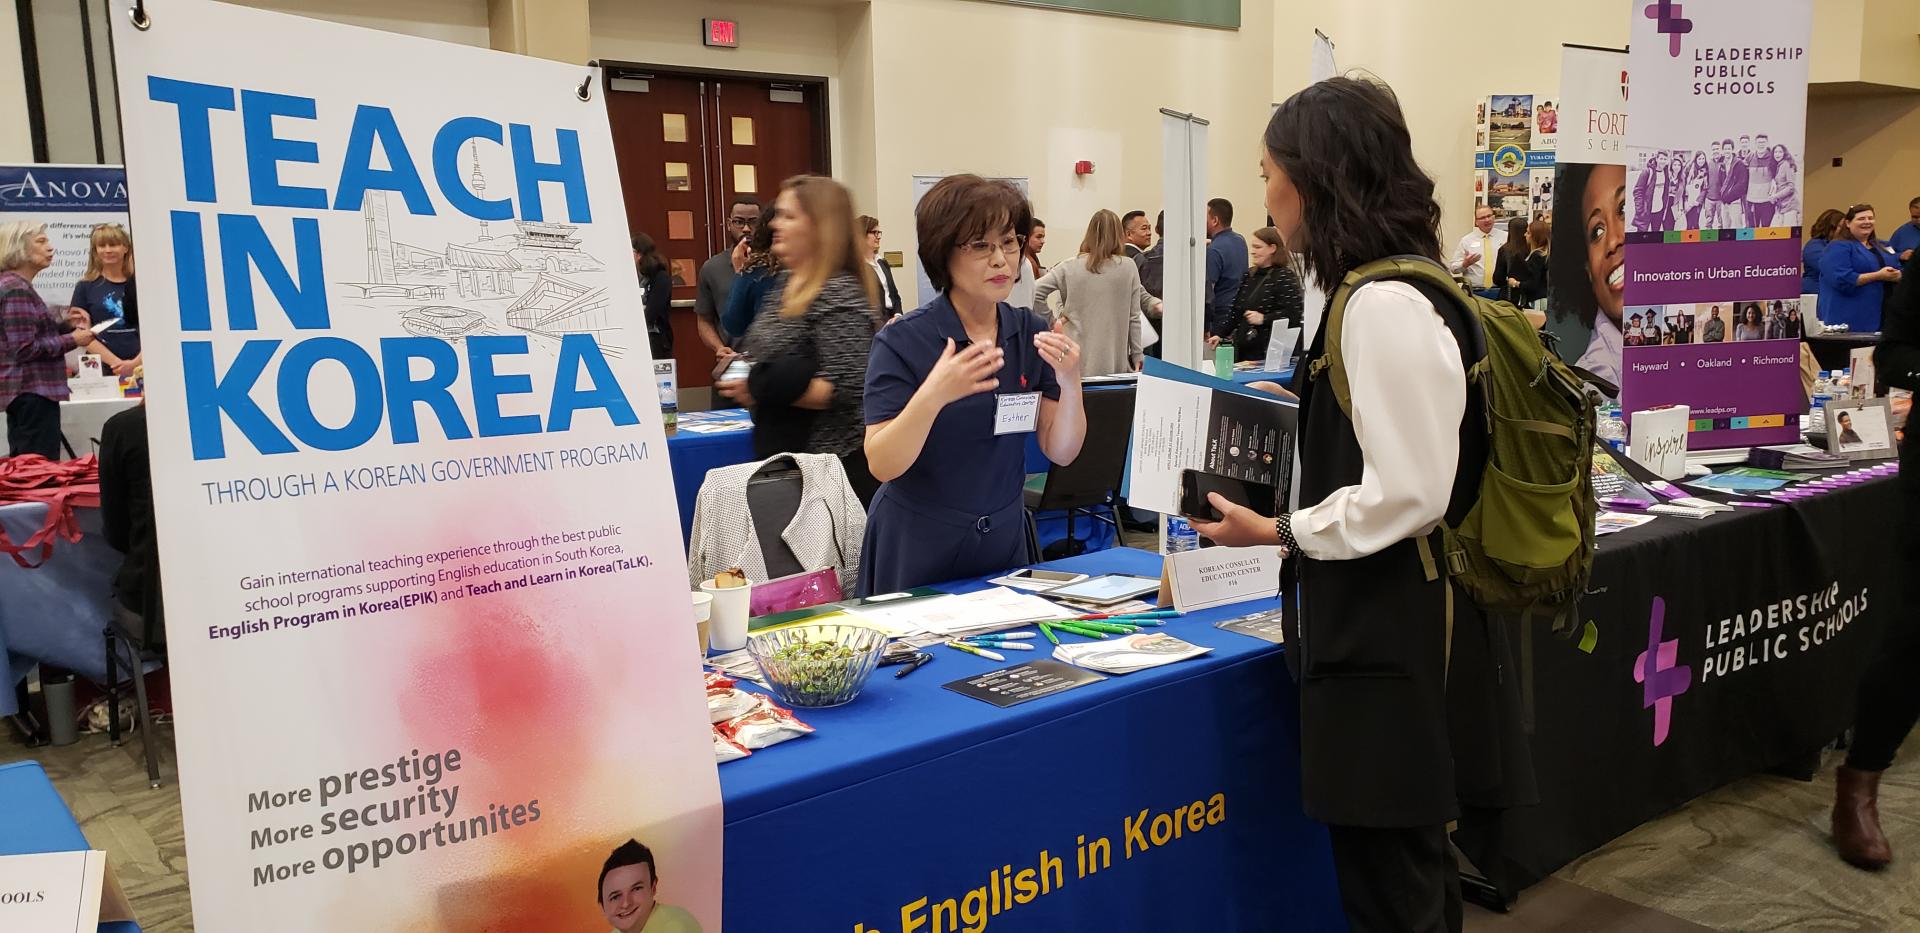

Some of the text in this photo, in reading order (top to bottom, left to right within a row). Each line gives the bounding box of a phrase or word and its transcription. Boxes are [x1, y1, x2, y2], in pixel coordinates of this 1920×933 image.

[1694, 64, 1757, 78] PUBLIC
[1695, 47, 1803, 61] LEADERSHIP
[1693, 81, 1775, 95] SCHOOLS
[147, 75, 593, 224] TEACH
[1588, 109, 1628, 135] FORT
[170, 210, 332, 331] IN
[1633, 264, 1798, 282] Innovators in Urban Education
[1632, 354, 1794, 374] Hayward Oakland Richmond
[181, 333, 641, 460] KOREA
[1001, 412, 1030, 423] Esther
[1689, 406, 1737, 415] www.leadps.org
[202, 442, 649, 505] THROUGH A KOREAN GOVERNMENT PROGRAM
[1644, 430, 1685, 474] inspire
[240, 525, 622, 590] Gain international teaching experience through the best public
[245, 544, 624, 613] school programs supporting English education in South Korea,
[1198, 557, 1261, 574] KOREAN CONSULATE
[1201, 566, 1261, 582] EDUCATION CENTER
[208, 618, 270, 640] English
[273, 609, 340, 630] Program
[342, 605, 357, 618] in
[359, 591, 438, 615] Korea(EPIK)
[440, 586, 464, 601] and
[466, 580, 502, 597] Teach
[504, 575, 528, 590] and
[530, 571, 563, 586] Learn
[565, 568, 576, 580] in
[1702, 587, 1868, 683] PUBLIC SCHOOLS
[1705, 581, 1839, 649] LEADERSHIP
[248, 749, 462, 813] More prestige
[250, 785, 459, 850] More security
[253, 799, 541, 887] More opportunites
[900, 792, 1226, 933] English in Korea
